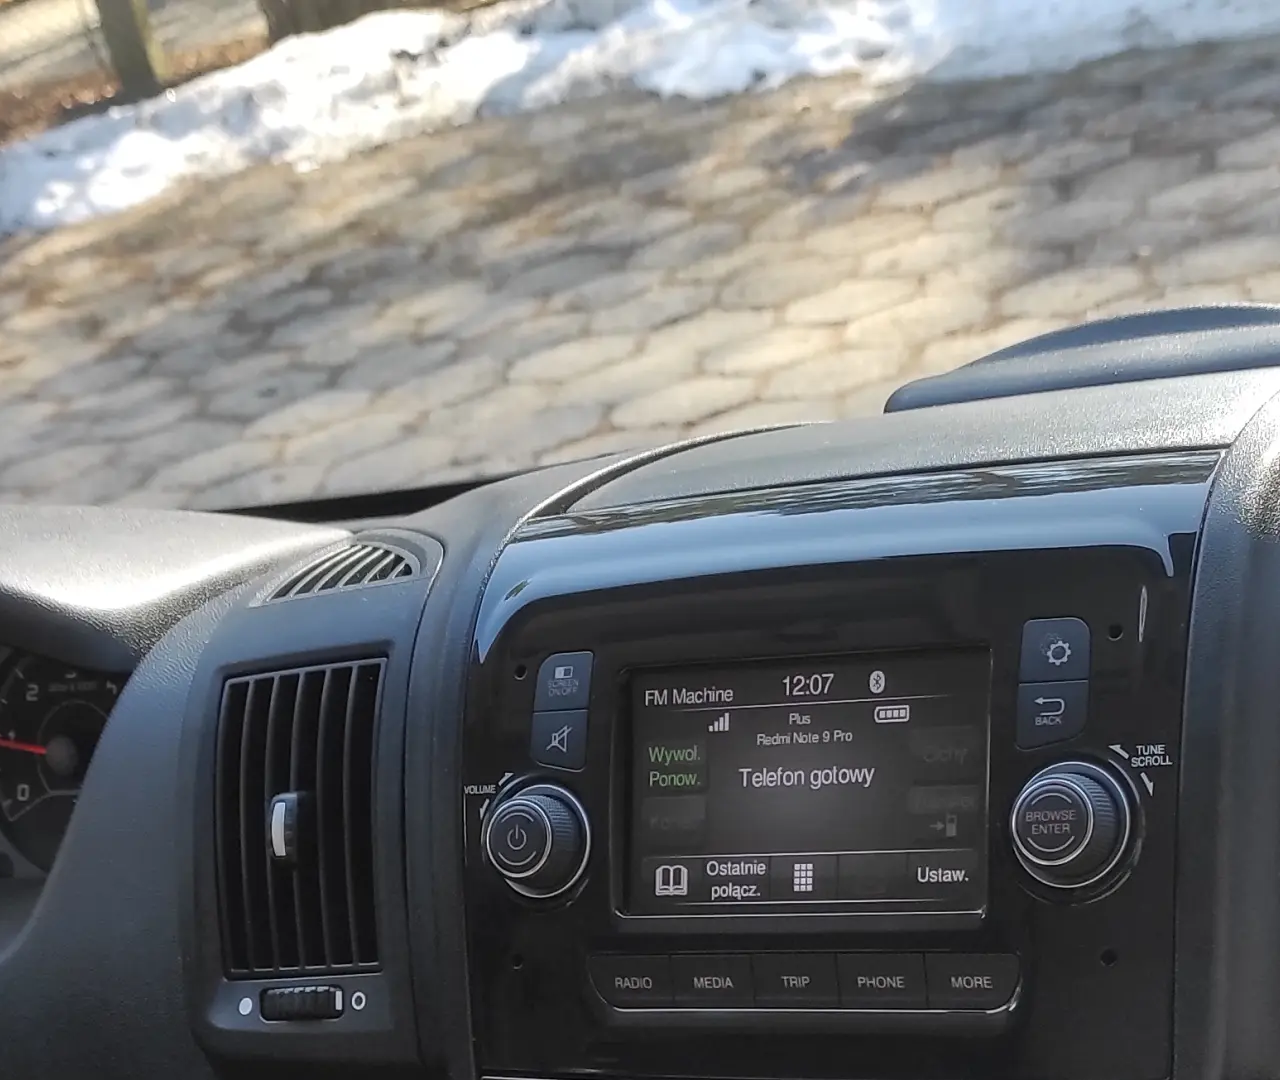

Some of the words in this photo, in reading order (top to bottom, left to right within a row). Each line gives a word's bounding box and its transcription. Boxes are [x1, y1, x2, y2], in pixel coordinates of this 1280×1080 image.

[782, 673, 834, 696] 12:07
[25, 683, 39, 701] 2
[644, 689, 668, 706] FM
[672, 686, 734, 704] Machine
[789, 713, 811, 725] Plus
[1035, 716, 1062, 726] BACK
[756, 732, 791, 746] Redmi
[793, 731, 819, 744] Note
[822, 730, 830, 743] 9
[833, 729, 853, 743] Pro
[1136, 744, 1166, 755] TUNE
[1131, 755, 1173, 768] SCROLL
[649, 770, 701, 788] Ponow.
[738, 767, 805, 788] Telefon
[810, 766, 875, 790] gotowy
[463, 785, 496, 795] VOLUME
[1025, 810, 1077, 822] BROWSE
[1031, 824, 1070, 835] ENTER
[706, 860, 767, 877] Ostatnie
[917, 866, 970, 883] Ustaw.
[614, 977, 652, 989] RADIO
[693, 976, 734, 989] MEDIA
[781, 975, 811, 988] TRIP
[857, 976, 905, 989] PHONE
[951, 976, 993, 989] MORE
